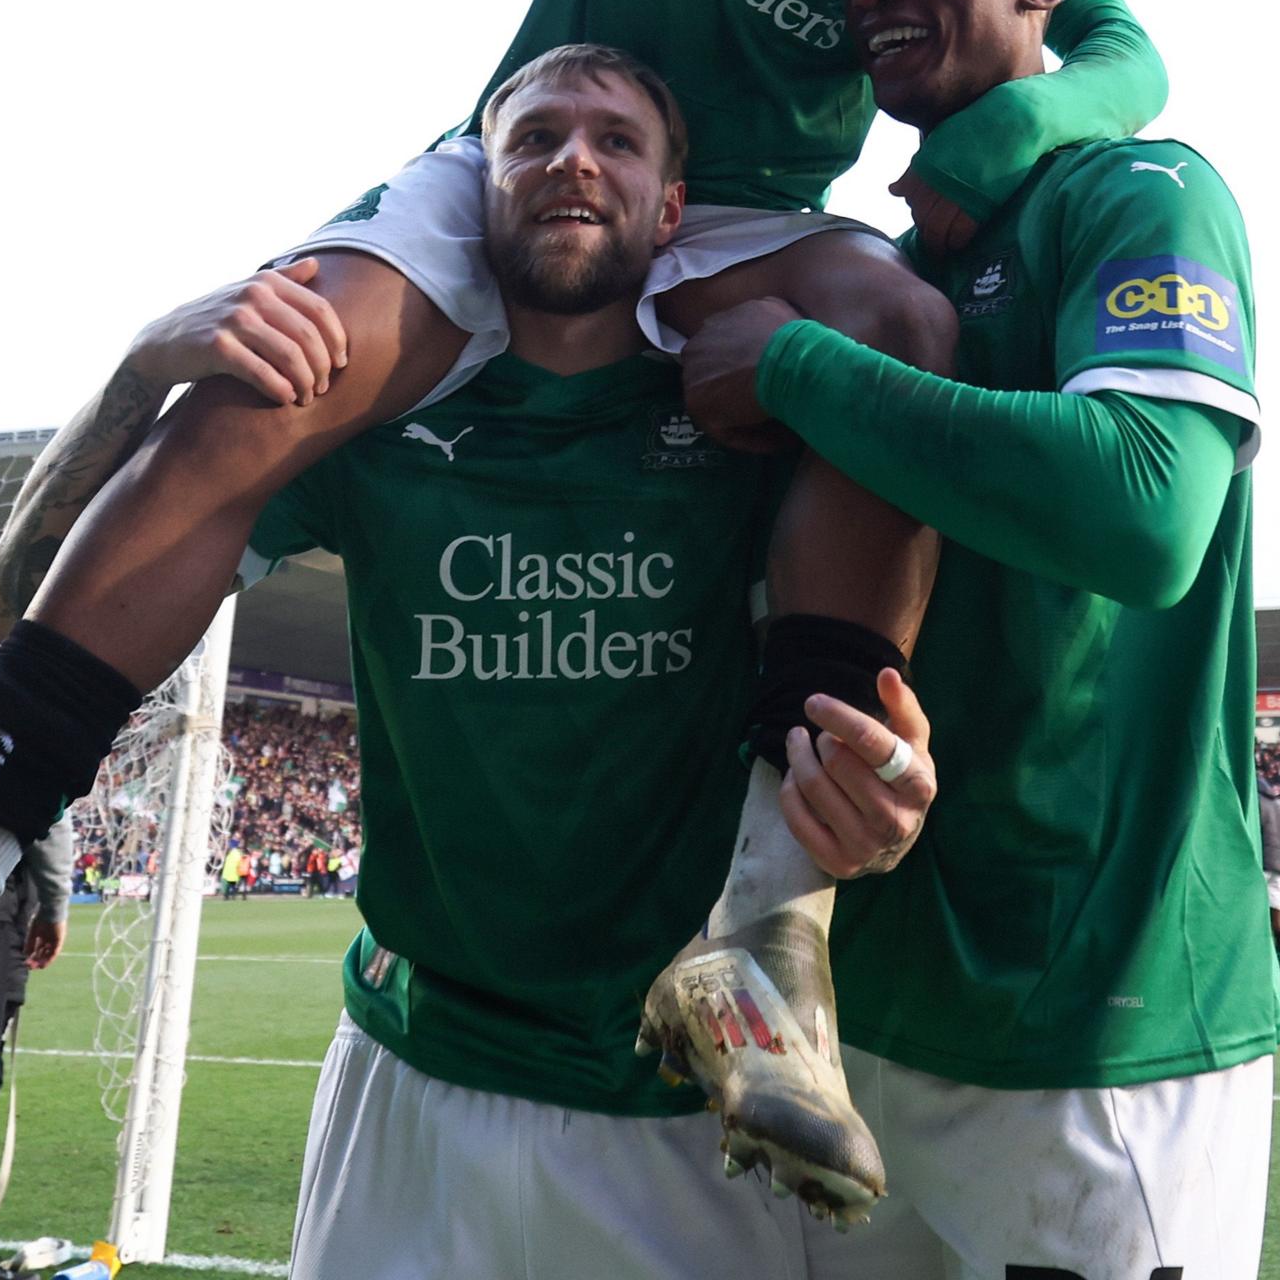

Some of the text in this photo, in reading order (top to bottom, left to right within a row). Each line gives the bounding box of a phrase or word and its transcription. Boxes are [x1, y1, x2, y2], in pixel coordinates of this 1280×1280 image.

[1128, 321, 1159, 332] Snag
[1161, 320, 1185, 330] List
[439, 531, 675, 602] Classic
[410, 609, 694, 681] Builders
